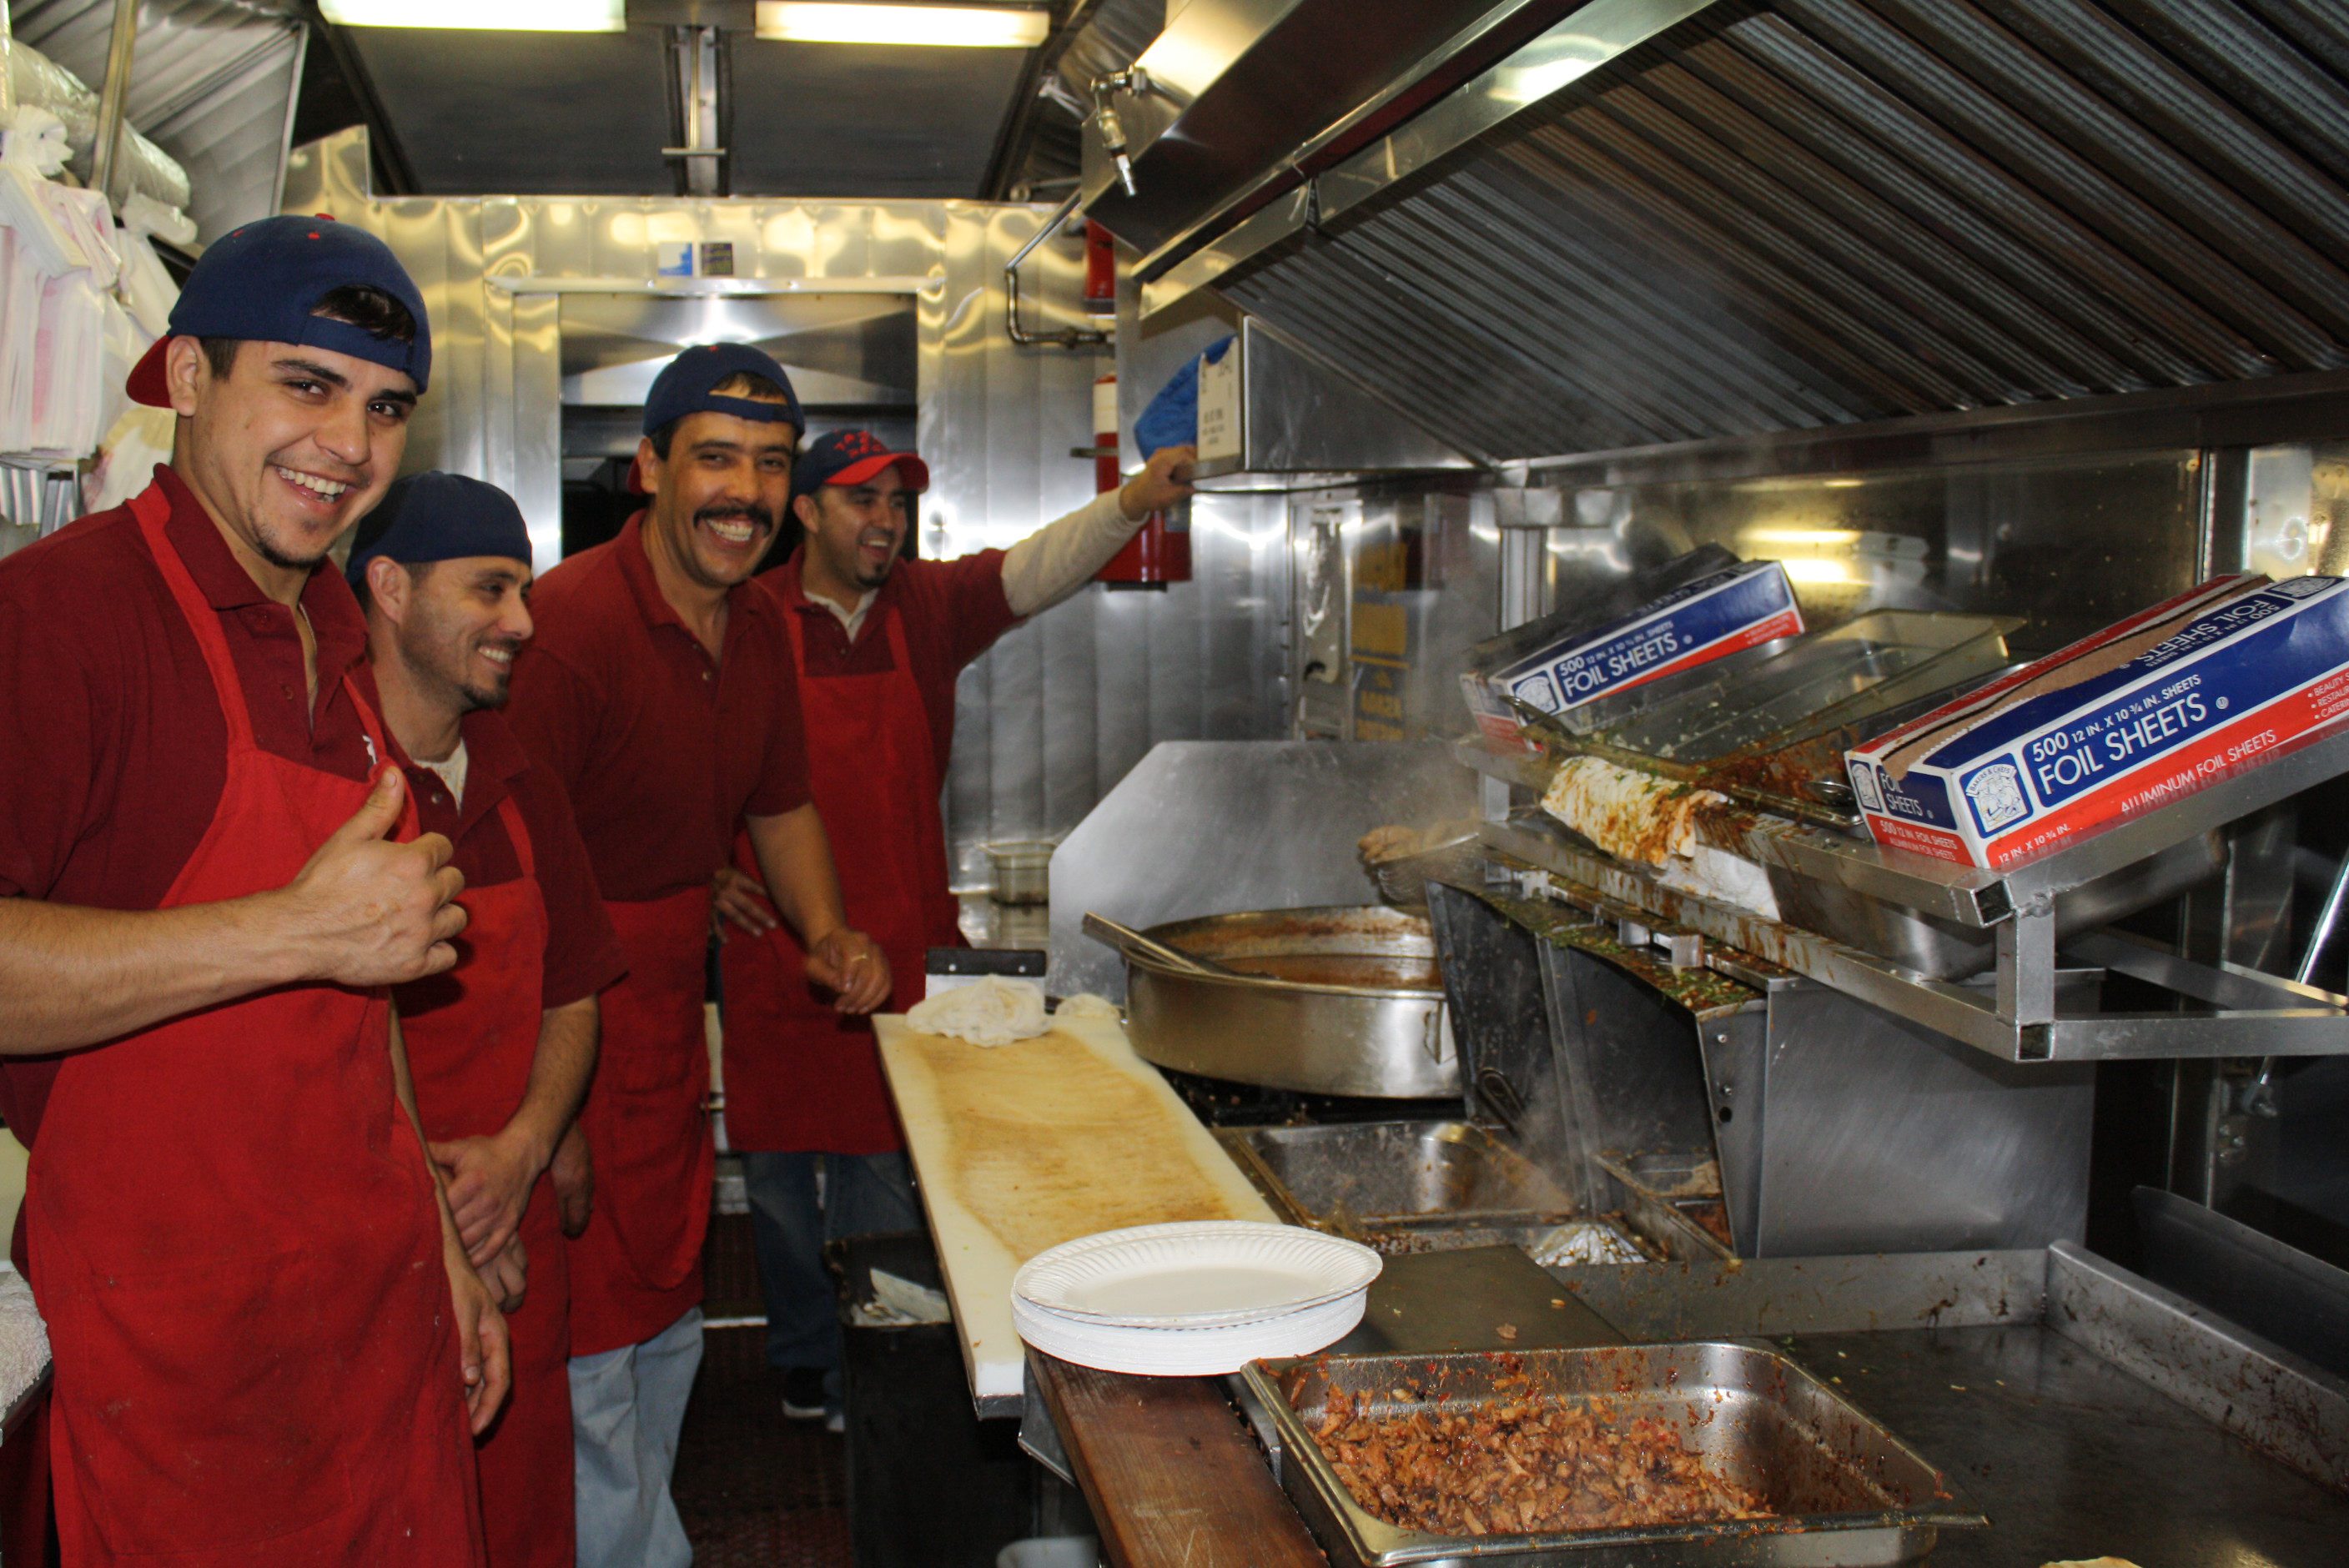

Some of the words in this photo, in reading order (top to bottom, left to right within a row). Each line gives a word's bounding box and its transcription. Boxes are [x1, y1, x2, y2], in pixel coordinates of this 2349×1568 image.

[2213, 600, 2270, 622] FOIL
[2250, 605, 2281, 619] 500
[2135, 623, 2218, 662] SHEETS
[1559, 656, 1585, 676] 500
[1562, 665, 1609, 697] FOIL
[1608, 632, 1678, 676] SHEETS
[2313, 676, 2344, 696] BEAUTY
[2033, 732, 2069, 761] 500
[2071, 730, 2085, 743] 12
[2085, 722, 2104, 736] IN.
[2104, 716, 2115, 727] X
[2115, 709, 2130, 721] 10
[2143, 695, 2161, 708] IN.
[2161, 674, 2201, 700] SHEETS
[2037, 745, 2105, 796] FOIL
[2105, 693, 2207, 761] SHEETS
[1969, 771, 1986, 792] BAKERS
[2121, 769, 2196, 812] ALUMINUM
[2196, 754, 2227, 777] FOIL
[2227, 729, 2277, 762] SHEETS
[1879, 773, 1904, 793] FOIL
[1886, 793, 1923, 817] SHEETS
[1879, 820, 1897, 835] 500
[1999, 852, 2009, 863] 12
[2009, 846, 2025, 859] IN.
[2025, 841, 2034, 851] X
[2034, 835, 2045, 846] 10
[2056, 823, 2071, 835] IN.
